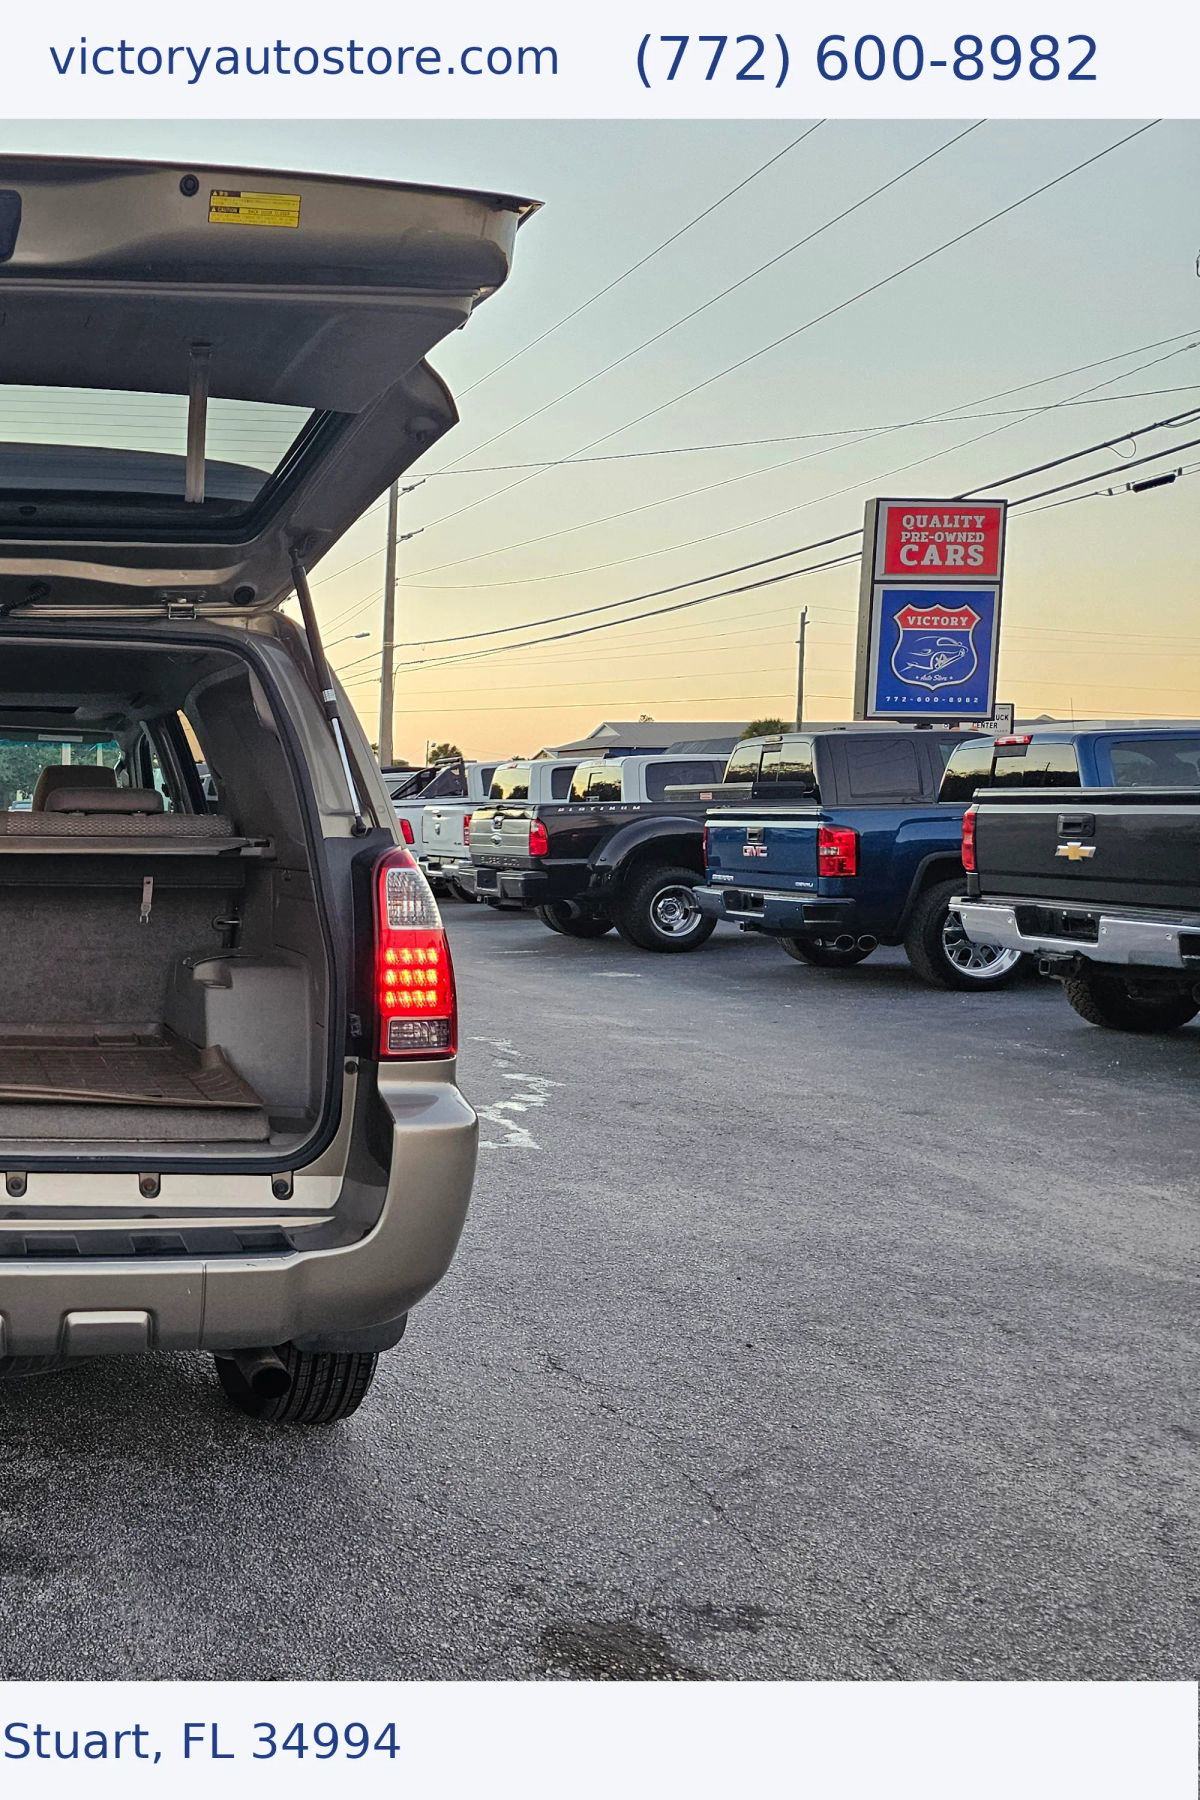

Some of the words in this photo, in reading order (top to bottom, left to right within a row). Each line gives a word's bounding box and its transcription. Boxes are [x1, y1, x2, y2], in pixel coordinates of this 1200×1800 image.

[902, 514, 986, 529] QUALITY
[900, 531, 985, 543] PRE-OWNED
[899, 544, 985, 566] CARS
[906, 615, 968, 626] VICTORY
[974, 721, 998, 729] ENTER
[742, 845, 768, 857] GMC
